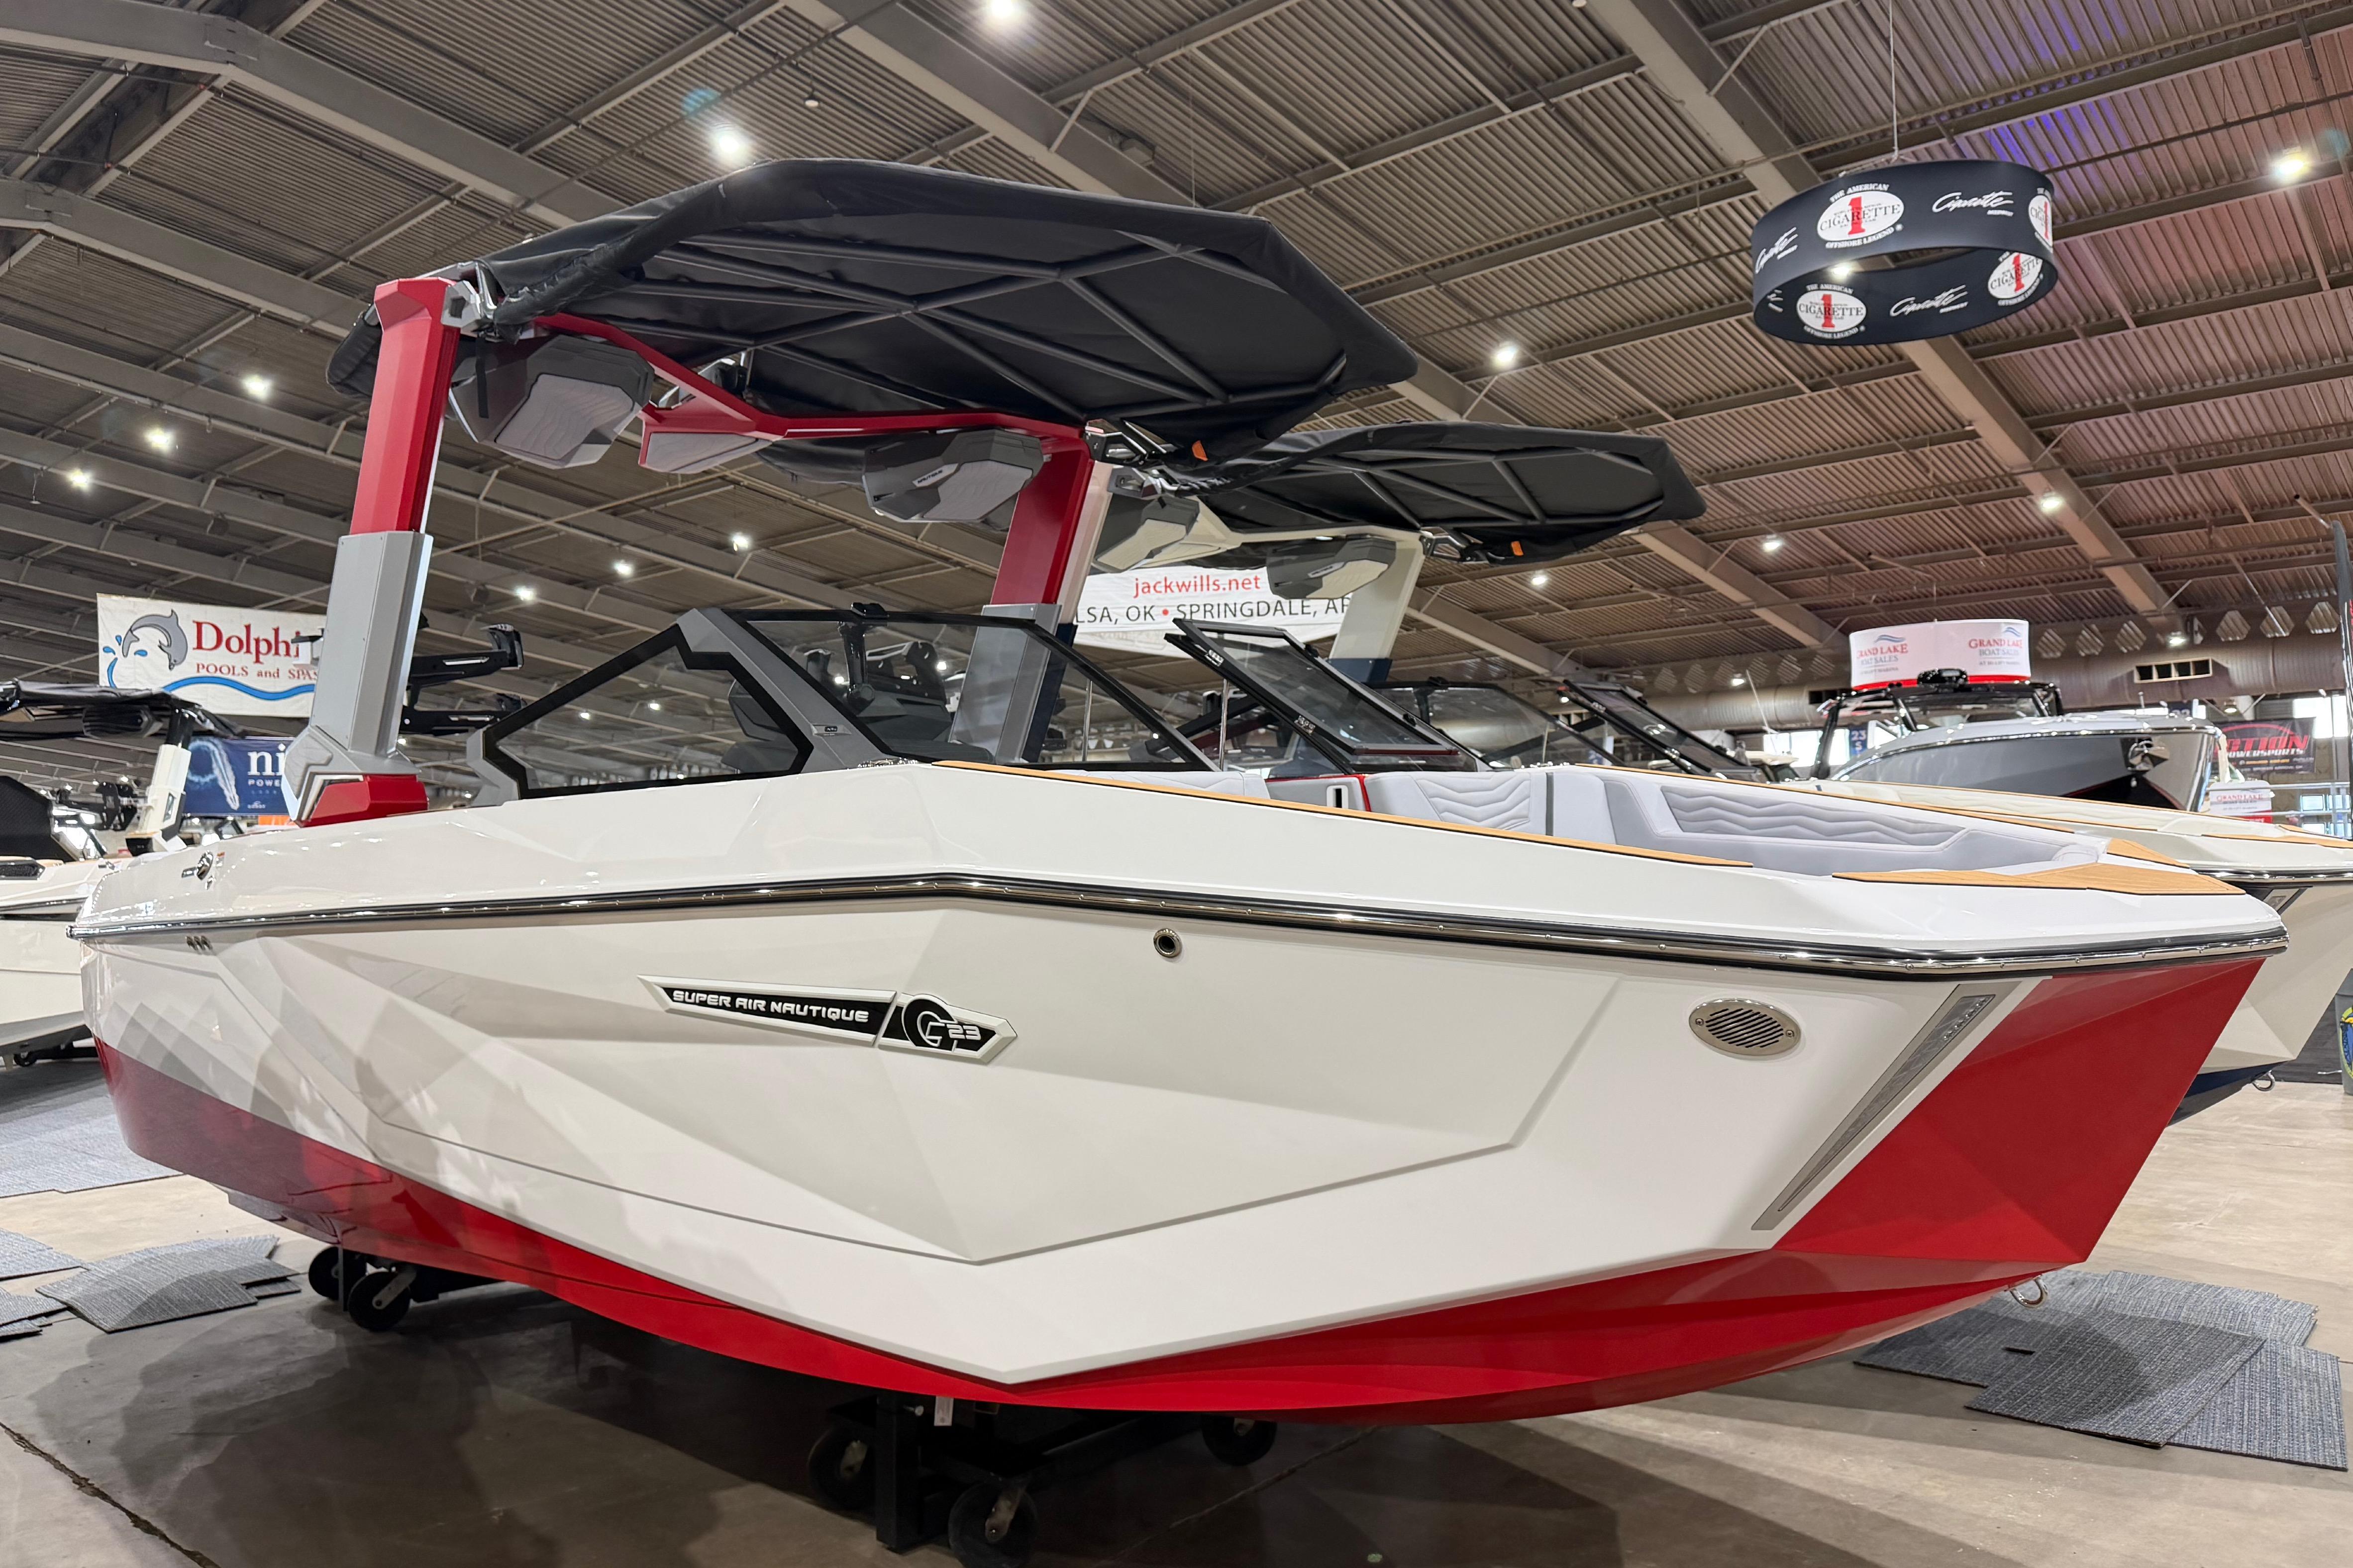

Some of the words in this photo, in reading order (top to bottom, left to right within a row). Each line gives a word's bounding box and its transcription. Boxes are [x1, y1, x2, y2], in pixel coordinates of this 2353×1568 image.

[1846, 183, 1890, 195] AMERICAN
[1820, 204, 1900, 231] CIGARETTE
[1820, 284, 1854, 295] AMERICAN
[1799, 303, 1864, 316] CIGARETTE
[1133, 575, 1261, 599] jackwills.net
[1075, 606, 1118, 625] LSA,
[1126, 605, 1155, 622] OK
[1176, 599, 1318, 620] SPRINGDALE,
[193, 620, 301, 665] Dolphi
[1879, 643, 1908, 656] LAKE
[1968, 638, 2006, 649] GRAND
[1874, 654, 1899, 664] SALES
[1979, 648, 2000, 657] BOAT
[196, 662, 249, 677] POOLS
[256, 667, 280, 679] and
[2226, 735, 2310, 753] OTION
[247, 743, 285, 776] ni
[2228, 748, 2304, 758] OWERSPORTS
[673, 990, 731, 1007] SUPER
[735, 997, 766, 1012] AIR
[770, 1001, 870, 1022] NAUTIQUE
